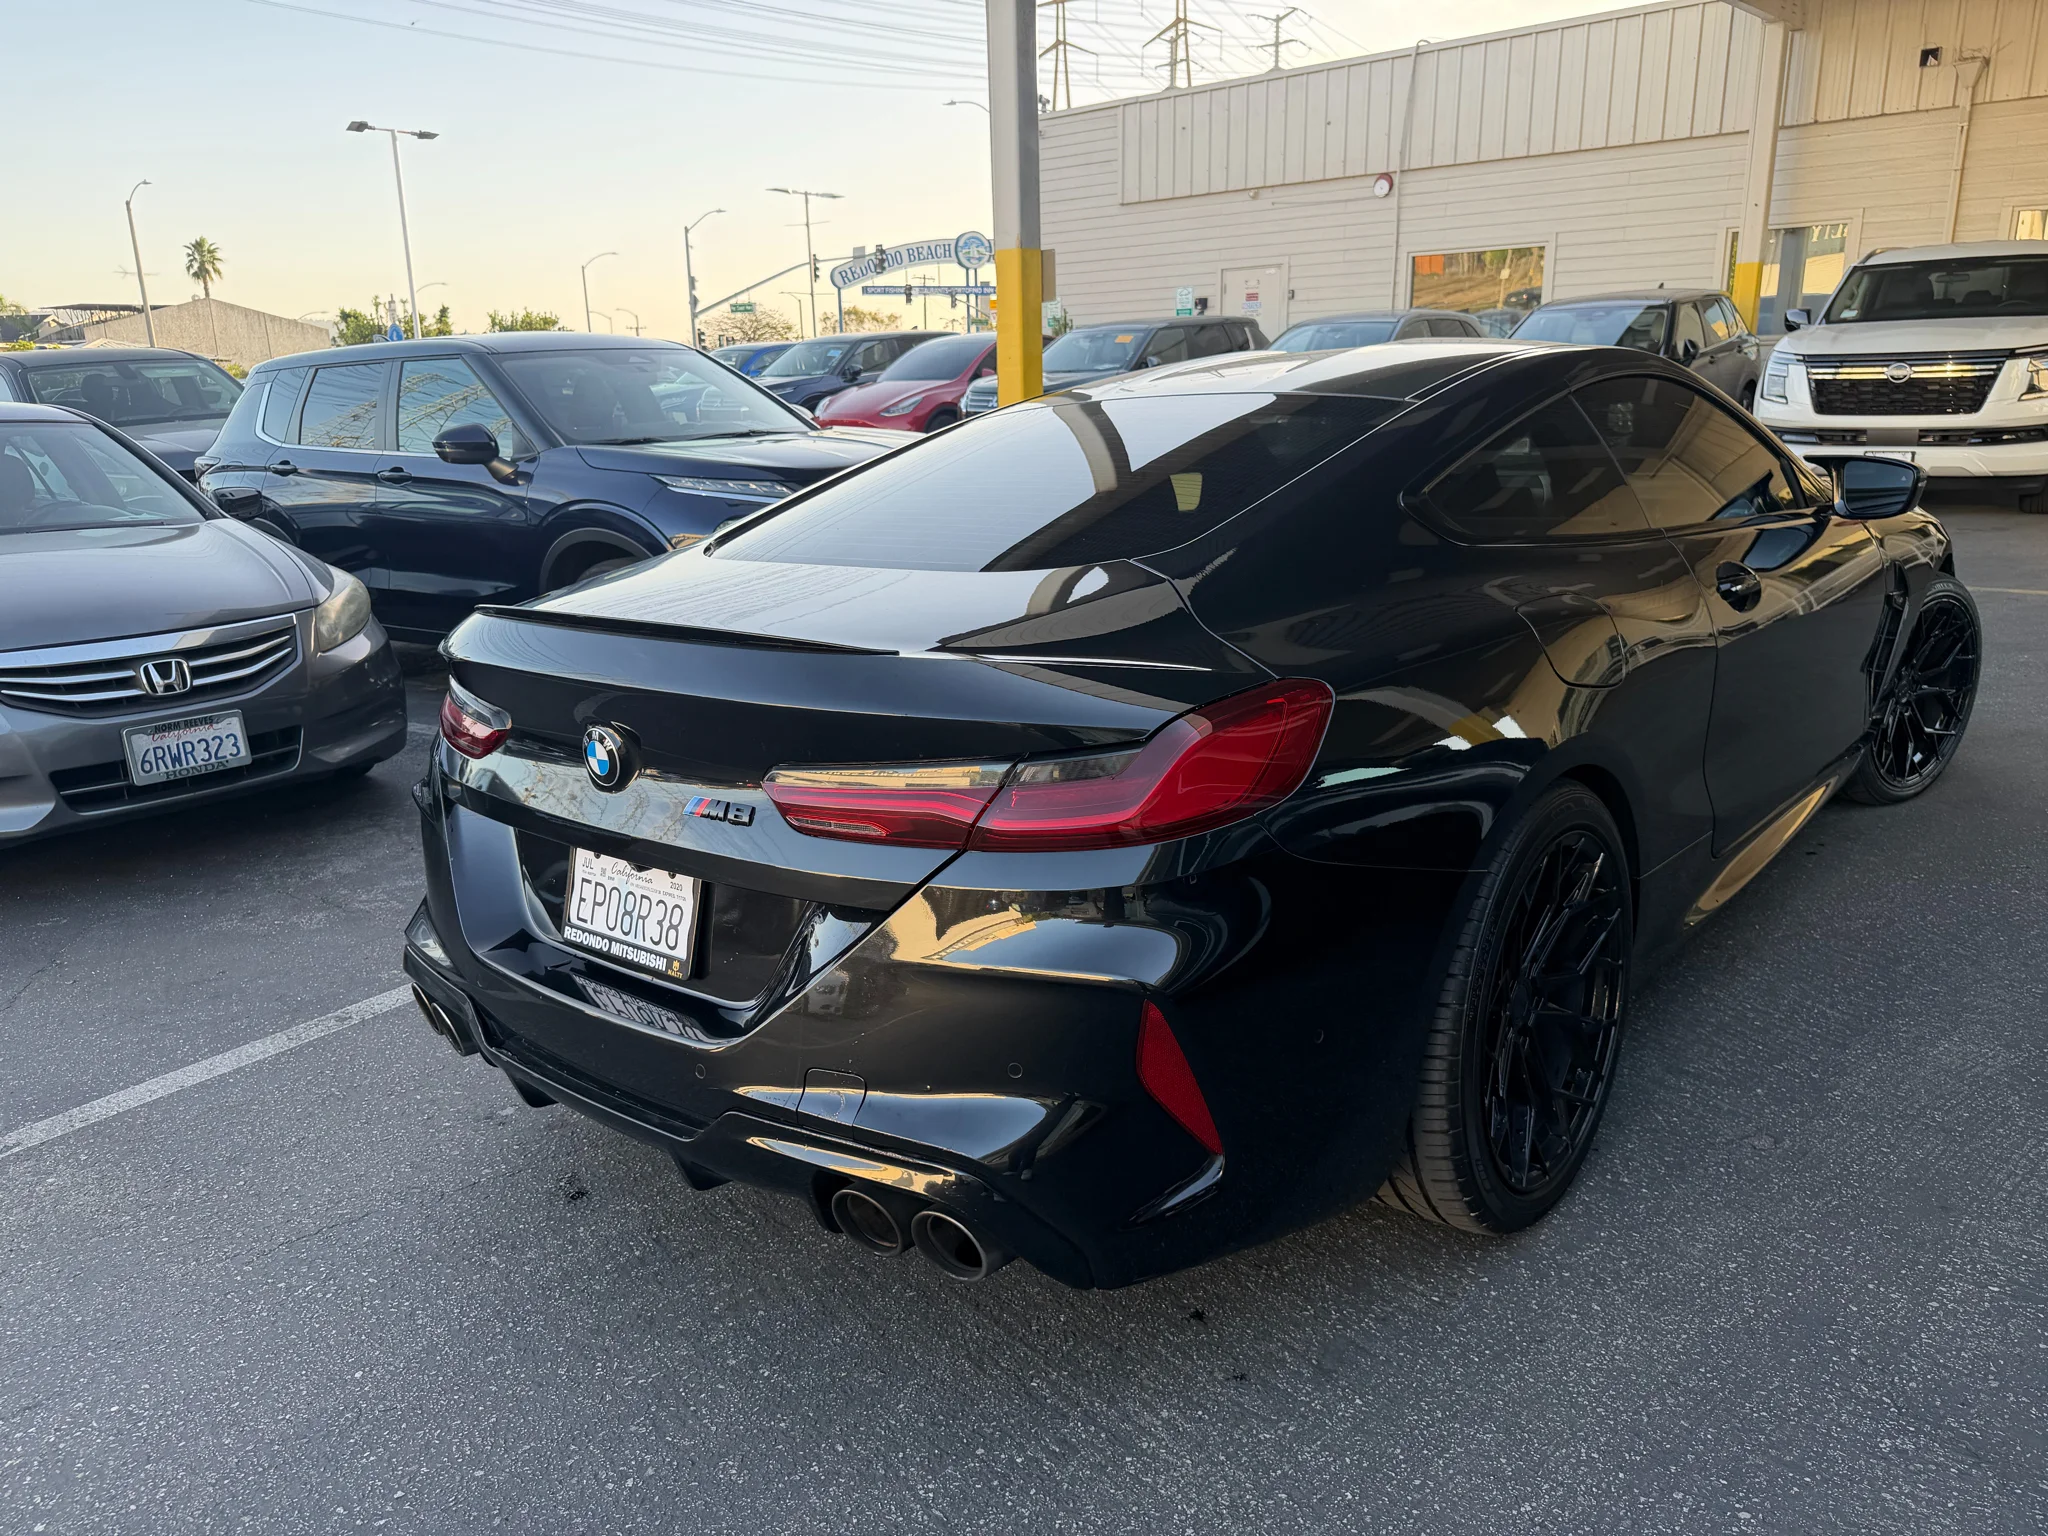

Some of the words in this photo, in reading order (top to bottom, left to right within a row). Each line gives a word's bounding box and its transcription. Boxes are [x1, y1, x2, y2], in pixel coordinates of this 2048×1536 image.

[838, 250, 903, 286] REDODO
[906, 243, 952, 263] BEACH
[154, 723, 181, 734] NORM
[183, 716, 214, 728] REEVES
[140, 733, 240, 774] 6RWR323
[584, 731, 614, 751] BMW
[163, 762, 229, 780] HONDA
[696, 798, 757, 828] M8
[582, 857, 594, 870] JUL
[611, 861, 654, 885] California
[576, 877, 684, 951] EP08R38
[563, 926, 610, 952] REDONDO
[610, 941, 667, 972] MITSUBISHI
